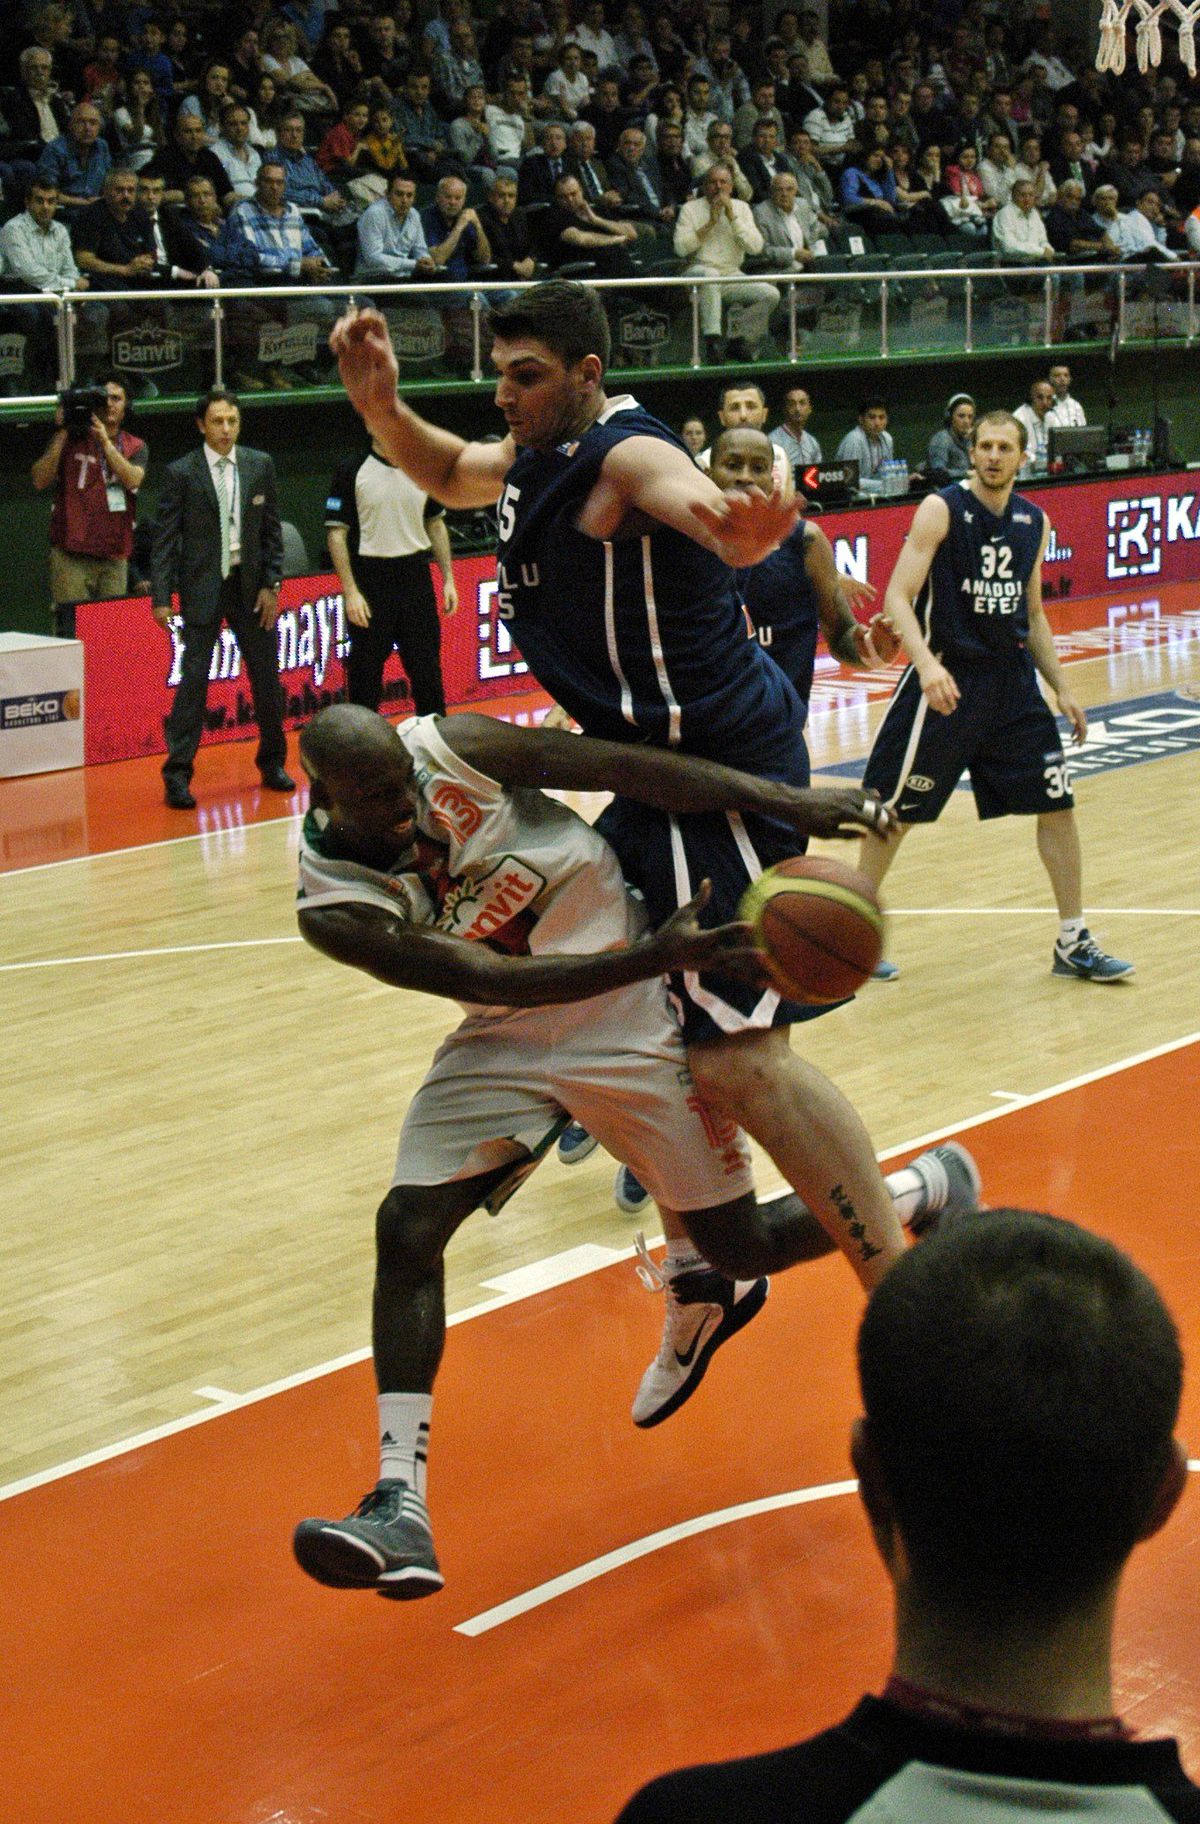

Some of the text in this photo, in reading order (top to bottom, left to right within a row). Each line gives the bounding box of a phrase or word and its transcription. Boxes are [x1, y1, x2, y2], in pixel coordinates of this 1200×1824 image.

[117, 340, 178, 363] Banvit
[818, 471, 844, 483] POSS
[497, 483, 521, 543] 5
[1167, 494, 1200, 543] K
[981, 545, 1014, 579] 32
[5, 699, 59, 720] BEKO
[462, 872, 535, 940] nvit
